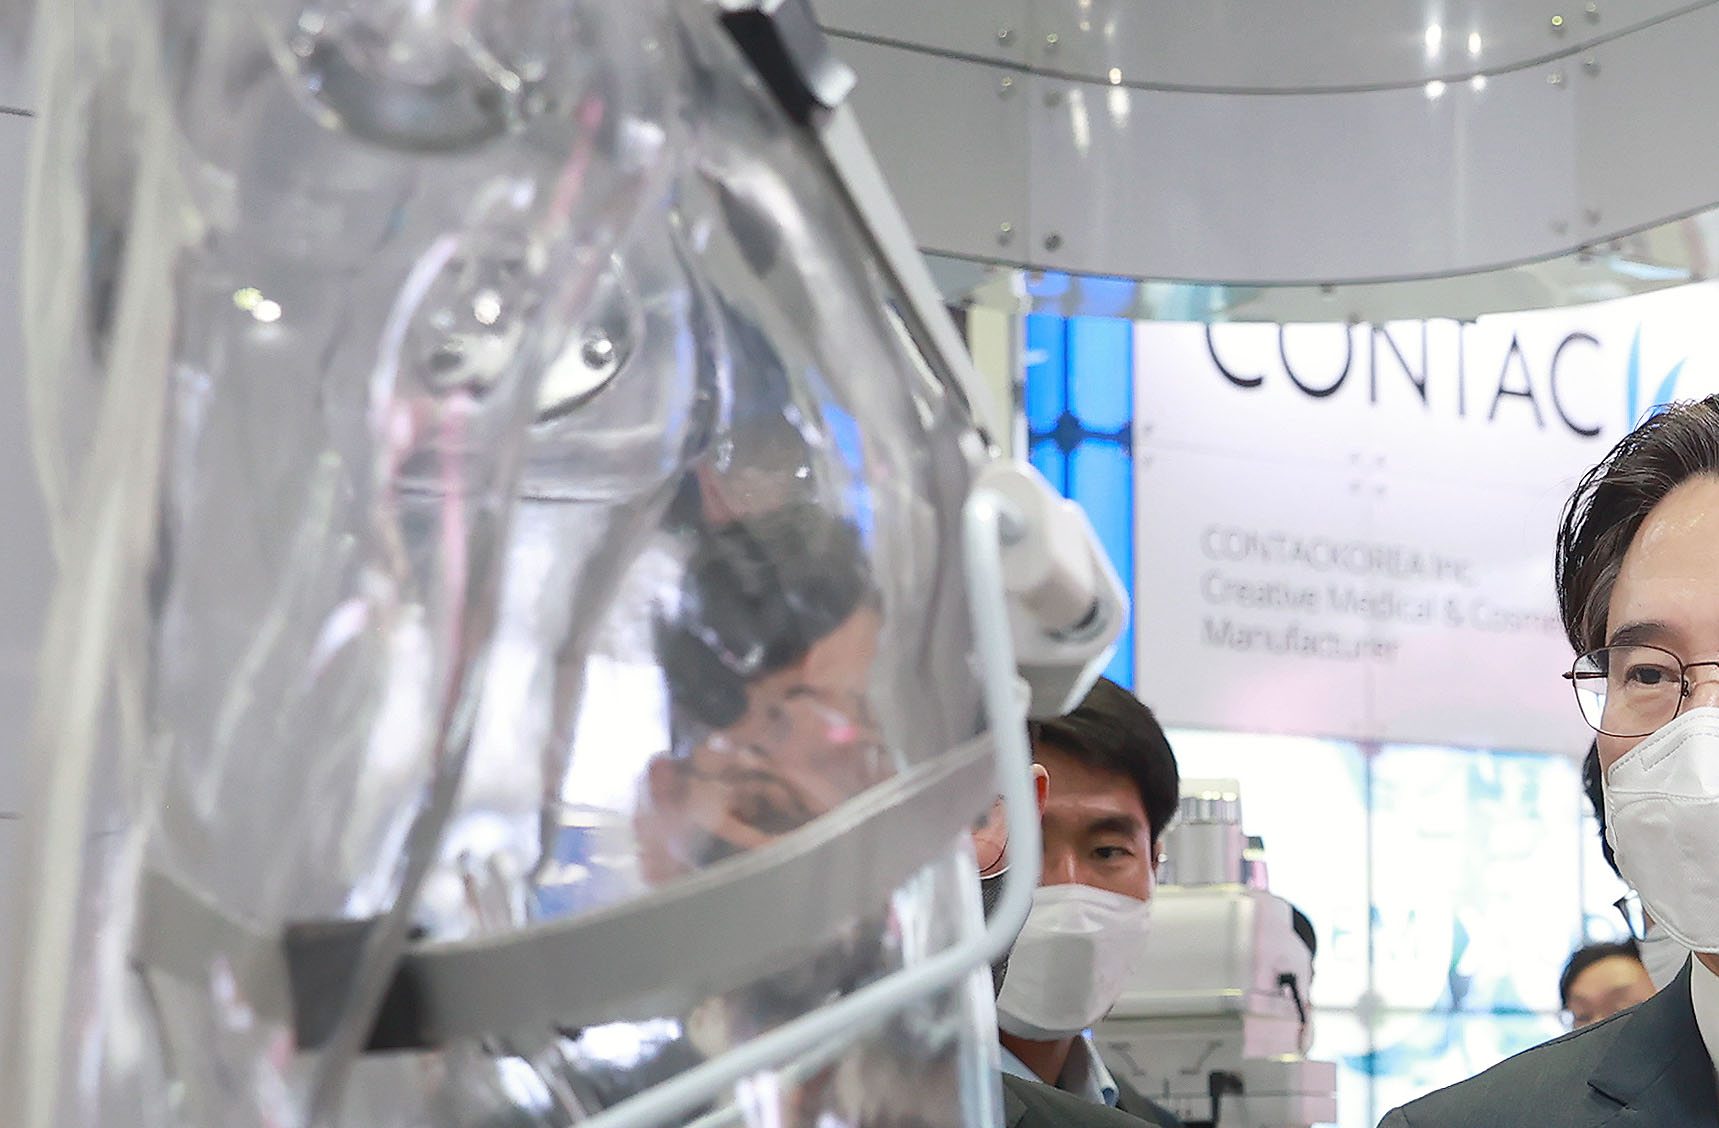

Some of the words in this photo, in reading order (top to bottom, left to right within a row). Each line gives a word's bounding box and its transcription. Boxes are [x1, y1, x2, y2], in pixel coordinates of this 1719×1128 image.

[1202, 569, 1319, 611] Creative
[1326, 582, 1432, 625] Medical
[1443, 596, 1464, 628] &
[1201, 616, 1400, 660] Manufacturer
